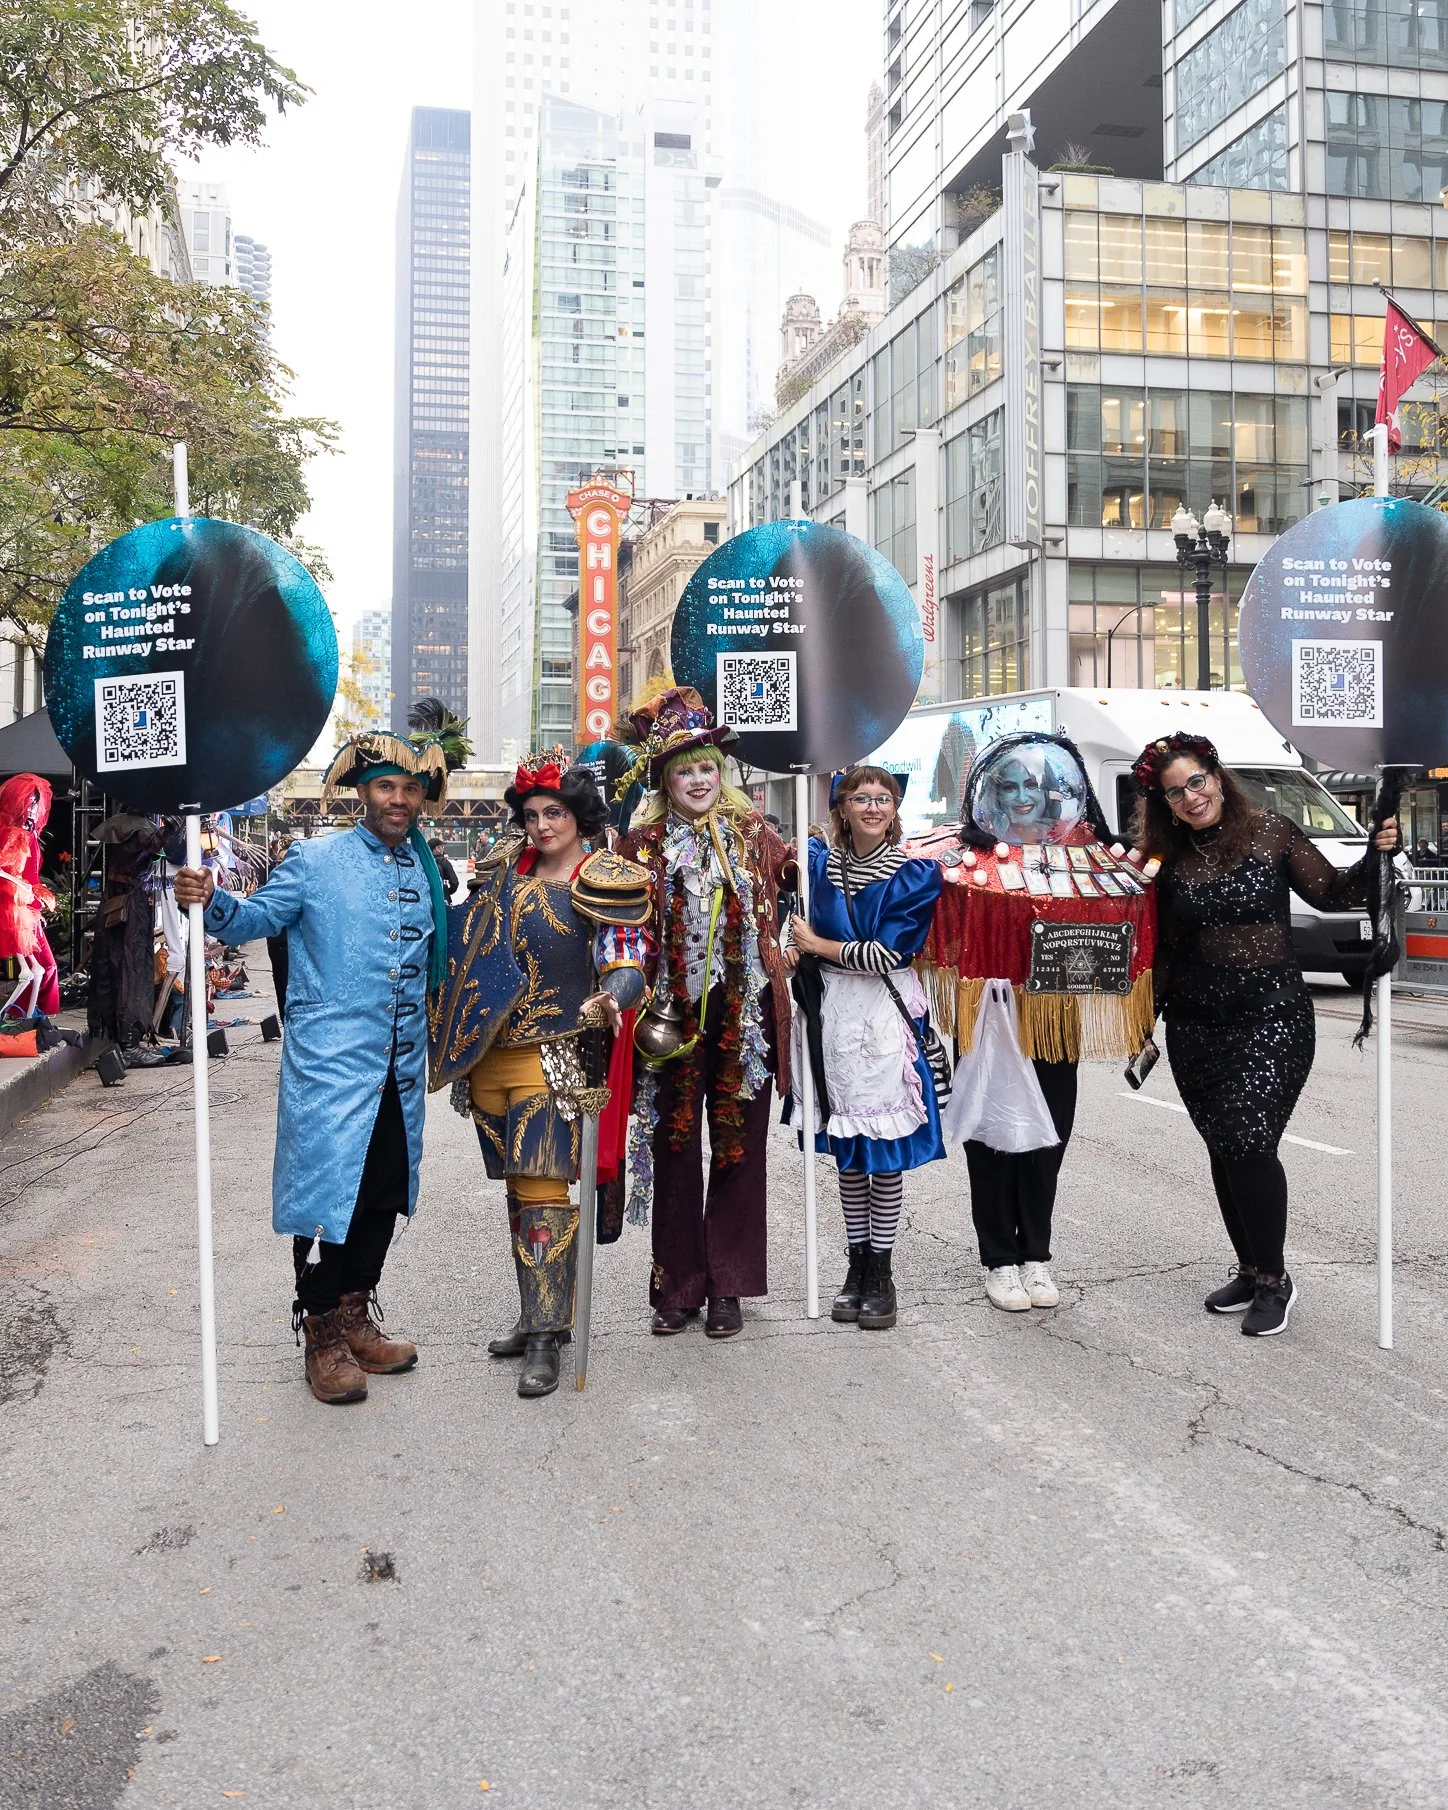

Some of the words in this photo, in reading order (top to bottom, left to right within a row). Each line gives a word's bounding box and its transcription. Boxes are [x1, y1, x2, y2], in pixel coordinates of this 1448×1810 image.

[1024, 339, 1039, 530] JOFFREY
[578, 489, 610, 502] CHASE
[1281, 557, 1325, 570] Scan
[1328, 558, 1348, 571] to
[1351, 558, 1392, 571] Vote
[707, 577, 745, 590] Scan
[749, 577, 766, 588] to
[769, 576, 805, 588] Vote
[1283, 576, 1305, 587] on
[82, 591, 125, 606] Scan
[128, 587, 147, 601] to
[150, 583, 192, 599] Vote
[708, 594, 728, 604] on
[921, 553, 939, 642] Walgreens
[1300, 590, 1375, 604] Haunted
[84, 611, 106, 623] on
[723, 606, 789, 619] Haunted
[1280, 607, 1352, 624] Runway
[1355, 608, 1394, 621] Star
[101, 619, 174, 640] Haunted
[586, 509, 612, 736] CHICAGO
[706, 623, 769, 637] Runway
[772, 622, 806, 634] Star
[82, 641, 152, 659] Runway
[155, 637, 195, 652] Star
[882, 758, 922, 773] Goodwill
[1047, 928, 1119, 941] ABCDEFGHIJKLM
[1042, 939, 1122, 951] NOPQRSTUVWXYZ
